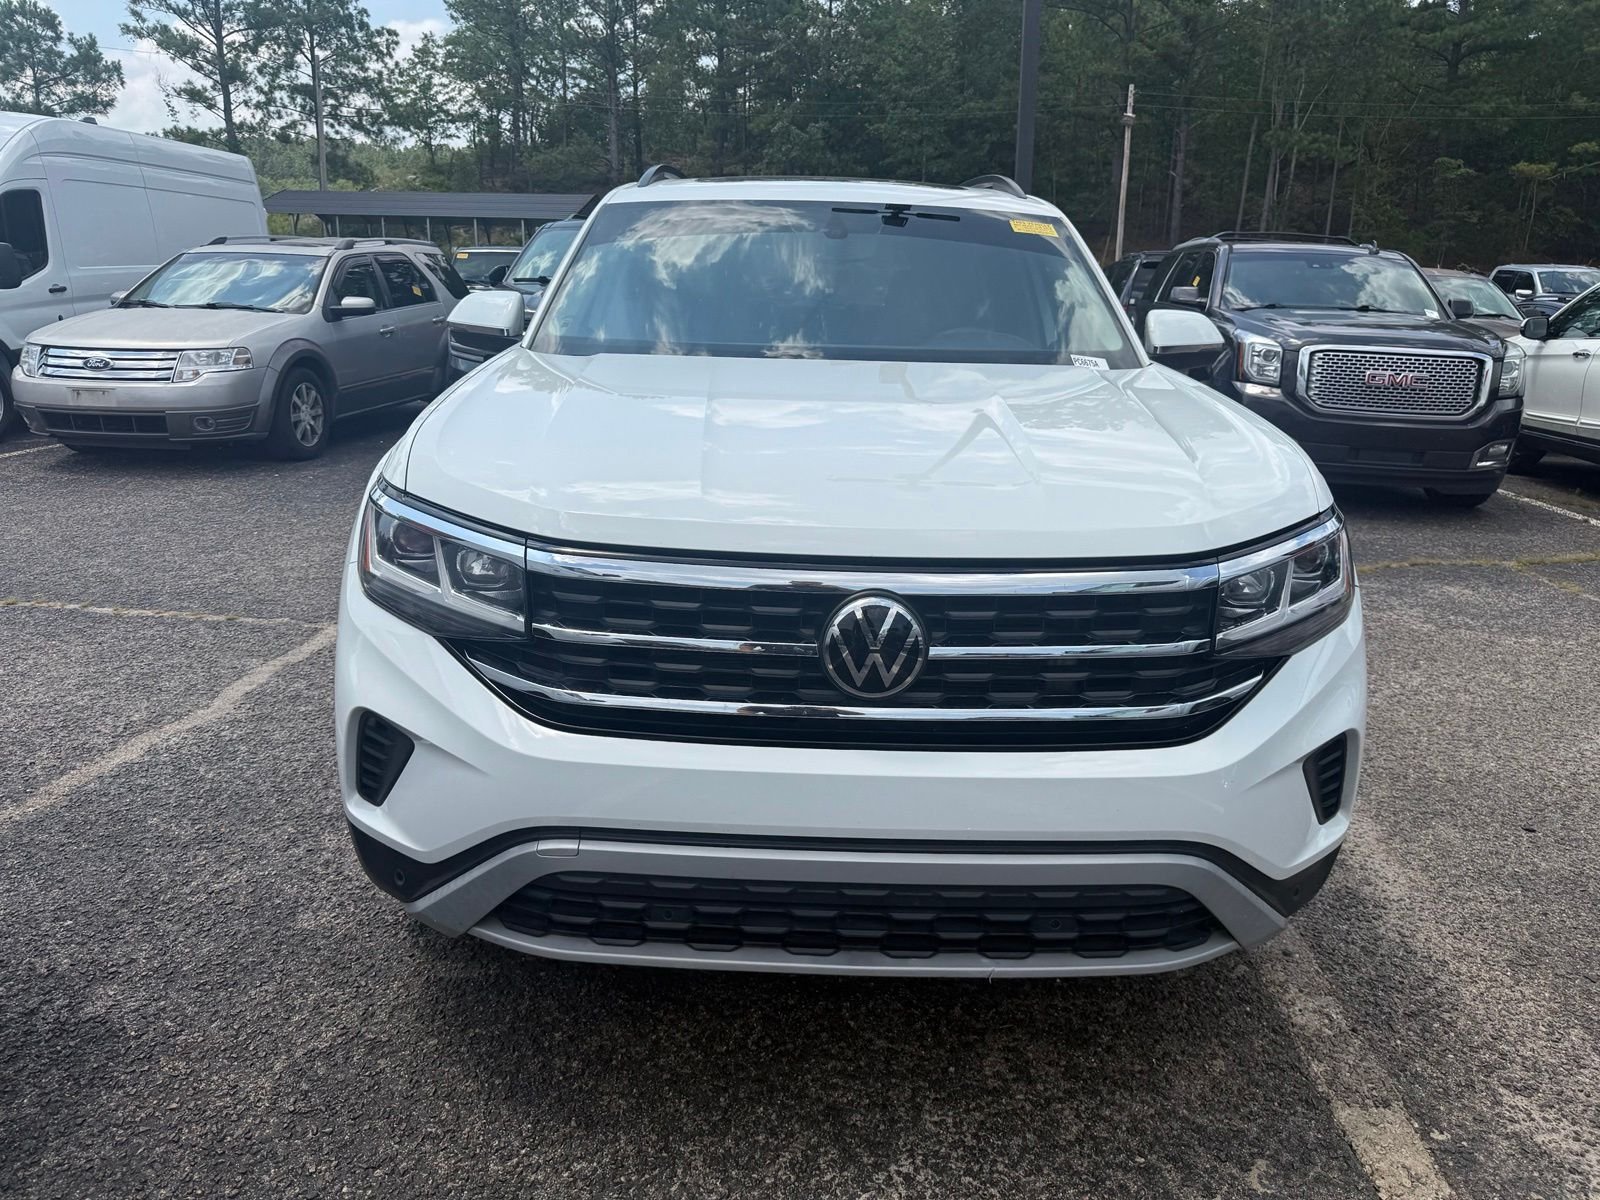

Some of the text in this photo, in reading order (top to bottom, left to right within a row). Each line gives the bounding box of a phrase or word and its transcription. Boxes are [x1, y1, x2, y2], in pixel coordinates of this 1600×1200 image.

[86, 358, 108, 368] Ford
[1365, 371, 1428, 388] GMC
[829, 600, 922, 689] VW
